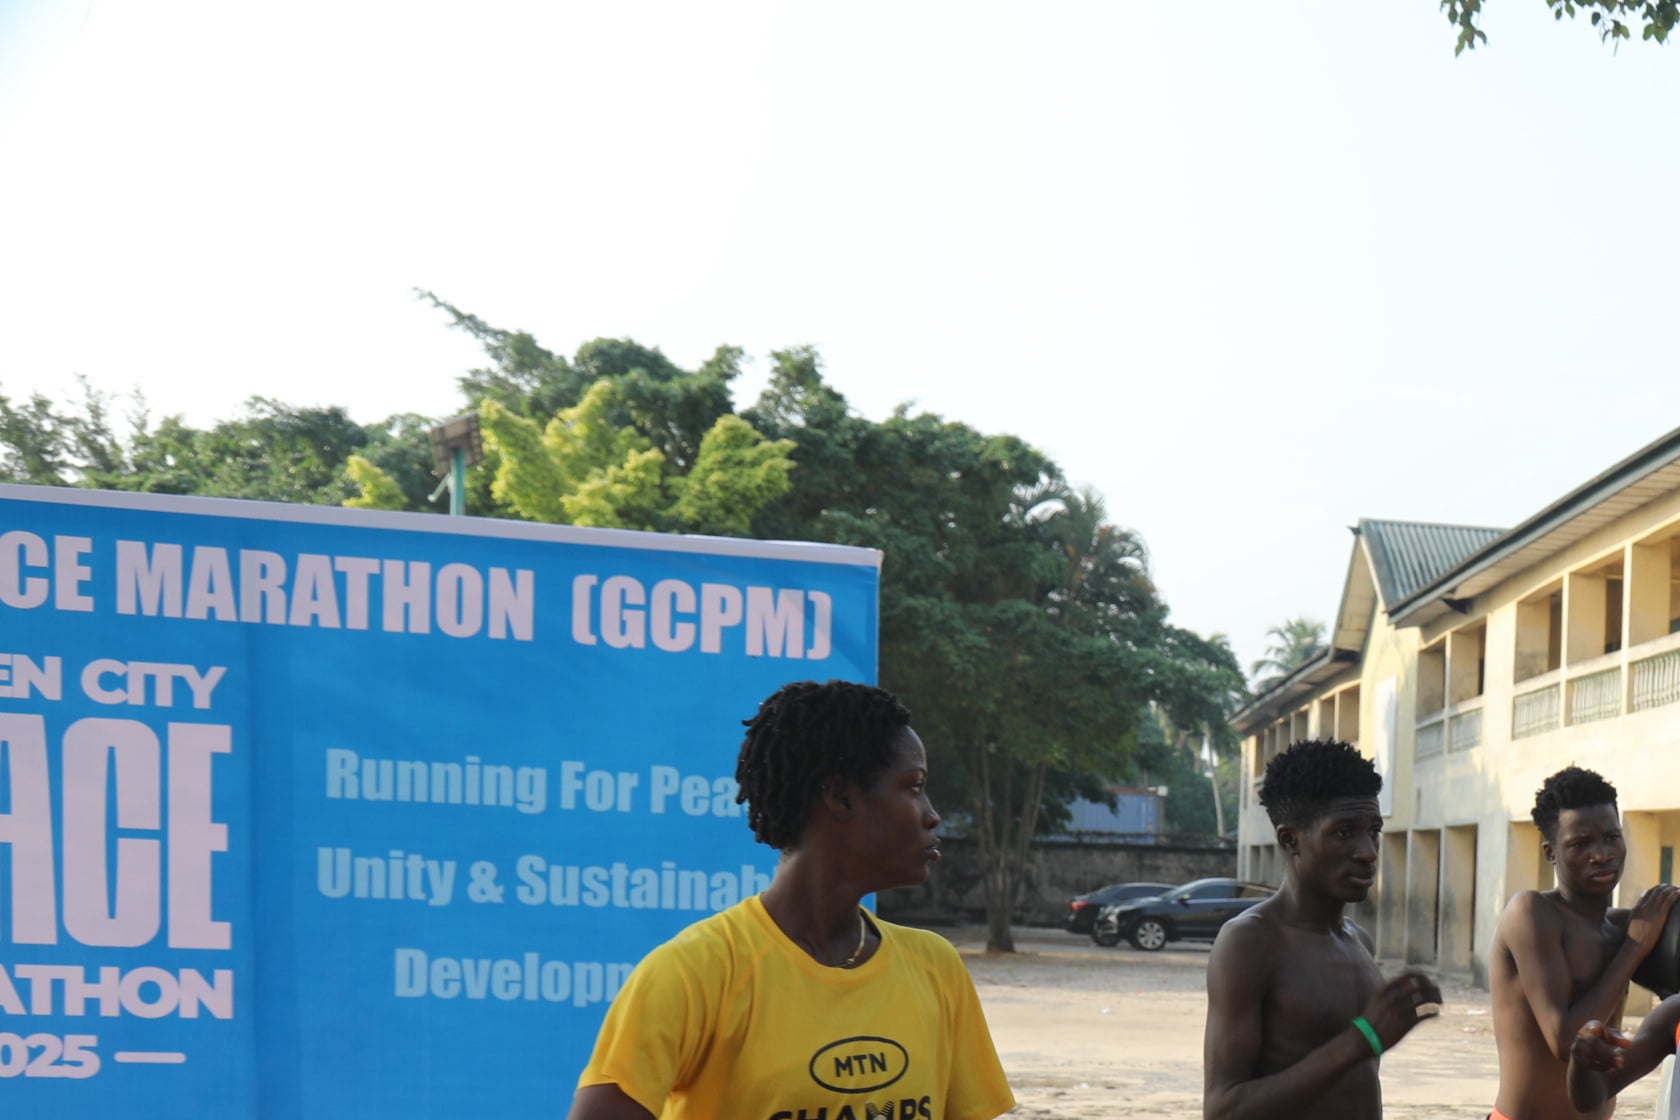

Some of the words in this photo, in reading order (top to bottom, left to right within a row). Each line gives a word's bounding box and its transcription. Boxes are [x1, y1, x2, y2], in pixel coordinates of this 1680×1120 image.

[116, 540, 534, 642] MARATHON
[81, 658, 227, 709] CITY
[326, 748, 547, 814] Running
[560, 760, 638, 812] For
[650, 765, 750, 817] Pea
[317, 847, 456, 906] Unity
[467, 861, 504, 903] &
[516, 855, 776, 911] Sustainab
[834, 1052, 888, 1078] MTN
